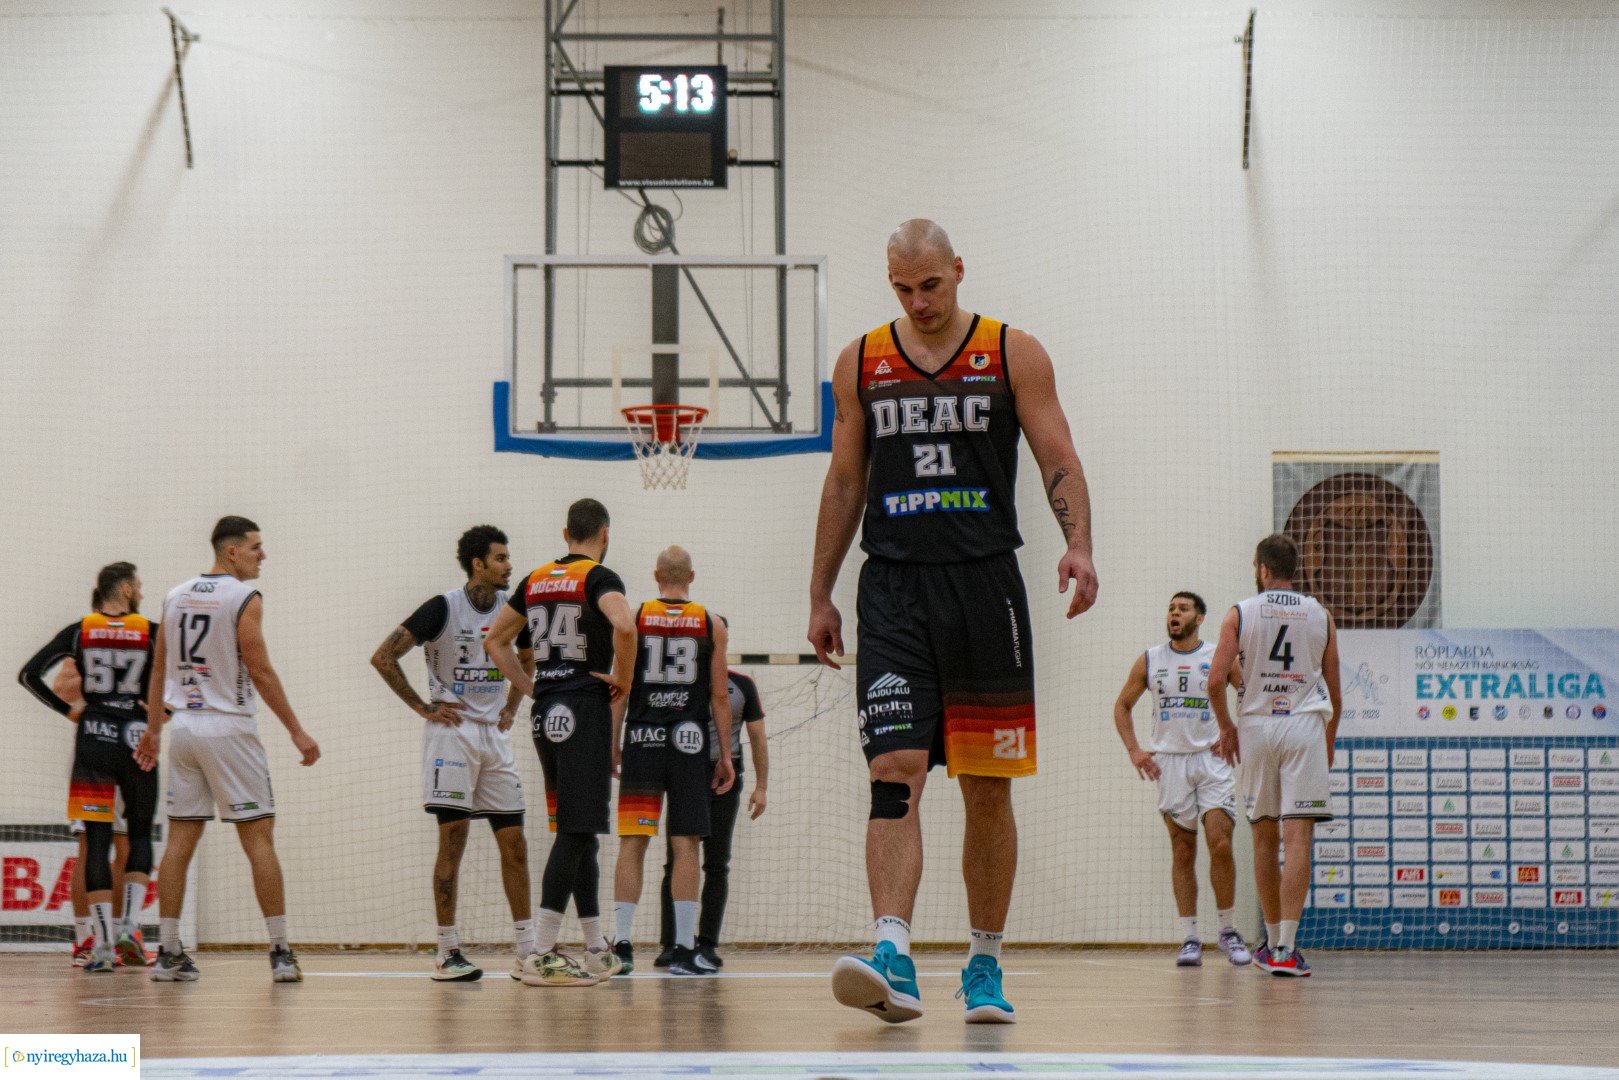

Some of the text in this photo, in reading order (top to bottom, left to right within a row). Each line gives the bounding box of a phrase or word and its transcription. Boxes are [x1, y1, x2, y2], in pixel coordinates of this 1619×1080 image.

[638, 73, 714, 112] 5:13
[871, 396, 991, 437] DEAC
[912, 443, 957, 478] 21
[529, 577, 579, 595] MÓCSÁN
[1266, 593, 1301, 606] SZOBI
[178, 613, 211, 664] 12
[527, 604, 588, 662] 24
[1008, 606, 1023, 668] PHARMAFLIGHT
[1269, 624, 1294, 671] 4
[83, 648, 148, 694] 57
[643, 635, 699, 684] 13
[649, 691, 690, 703] CAMPUS
[1179, 676, 1188, 692] 8
[1416, 673, 1607, 699] EXTRALIGA
[84, 720, 119, 738] MAG
[546, 715, 570, 733] HR
[630, 727, 667, 744] MAG
[679, 730, 701, 745] HR
[993, 727, 1028, 760] 21
